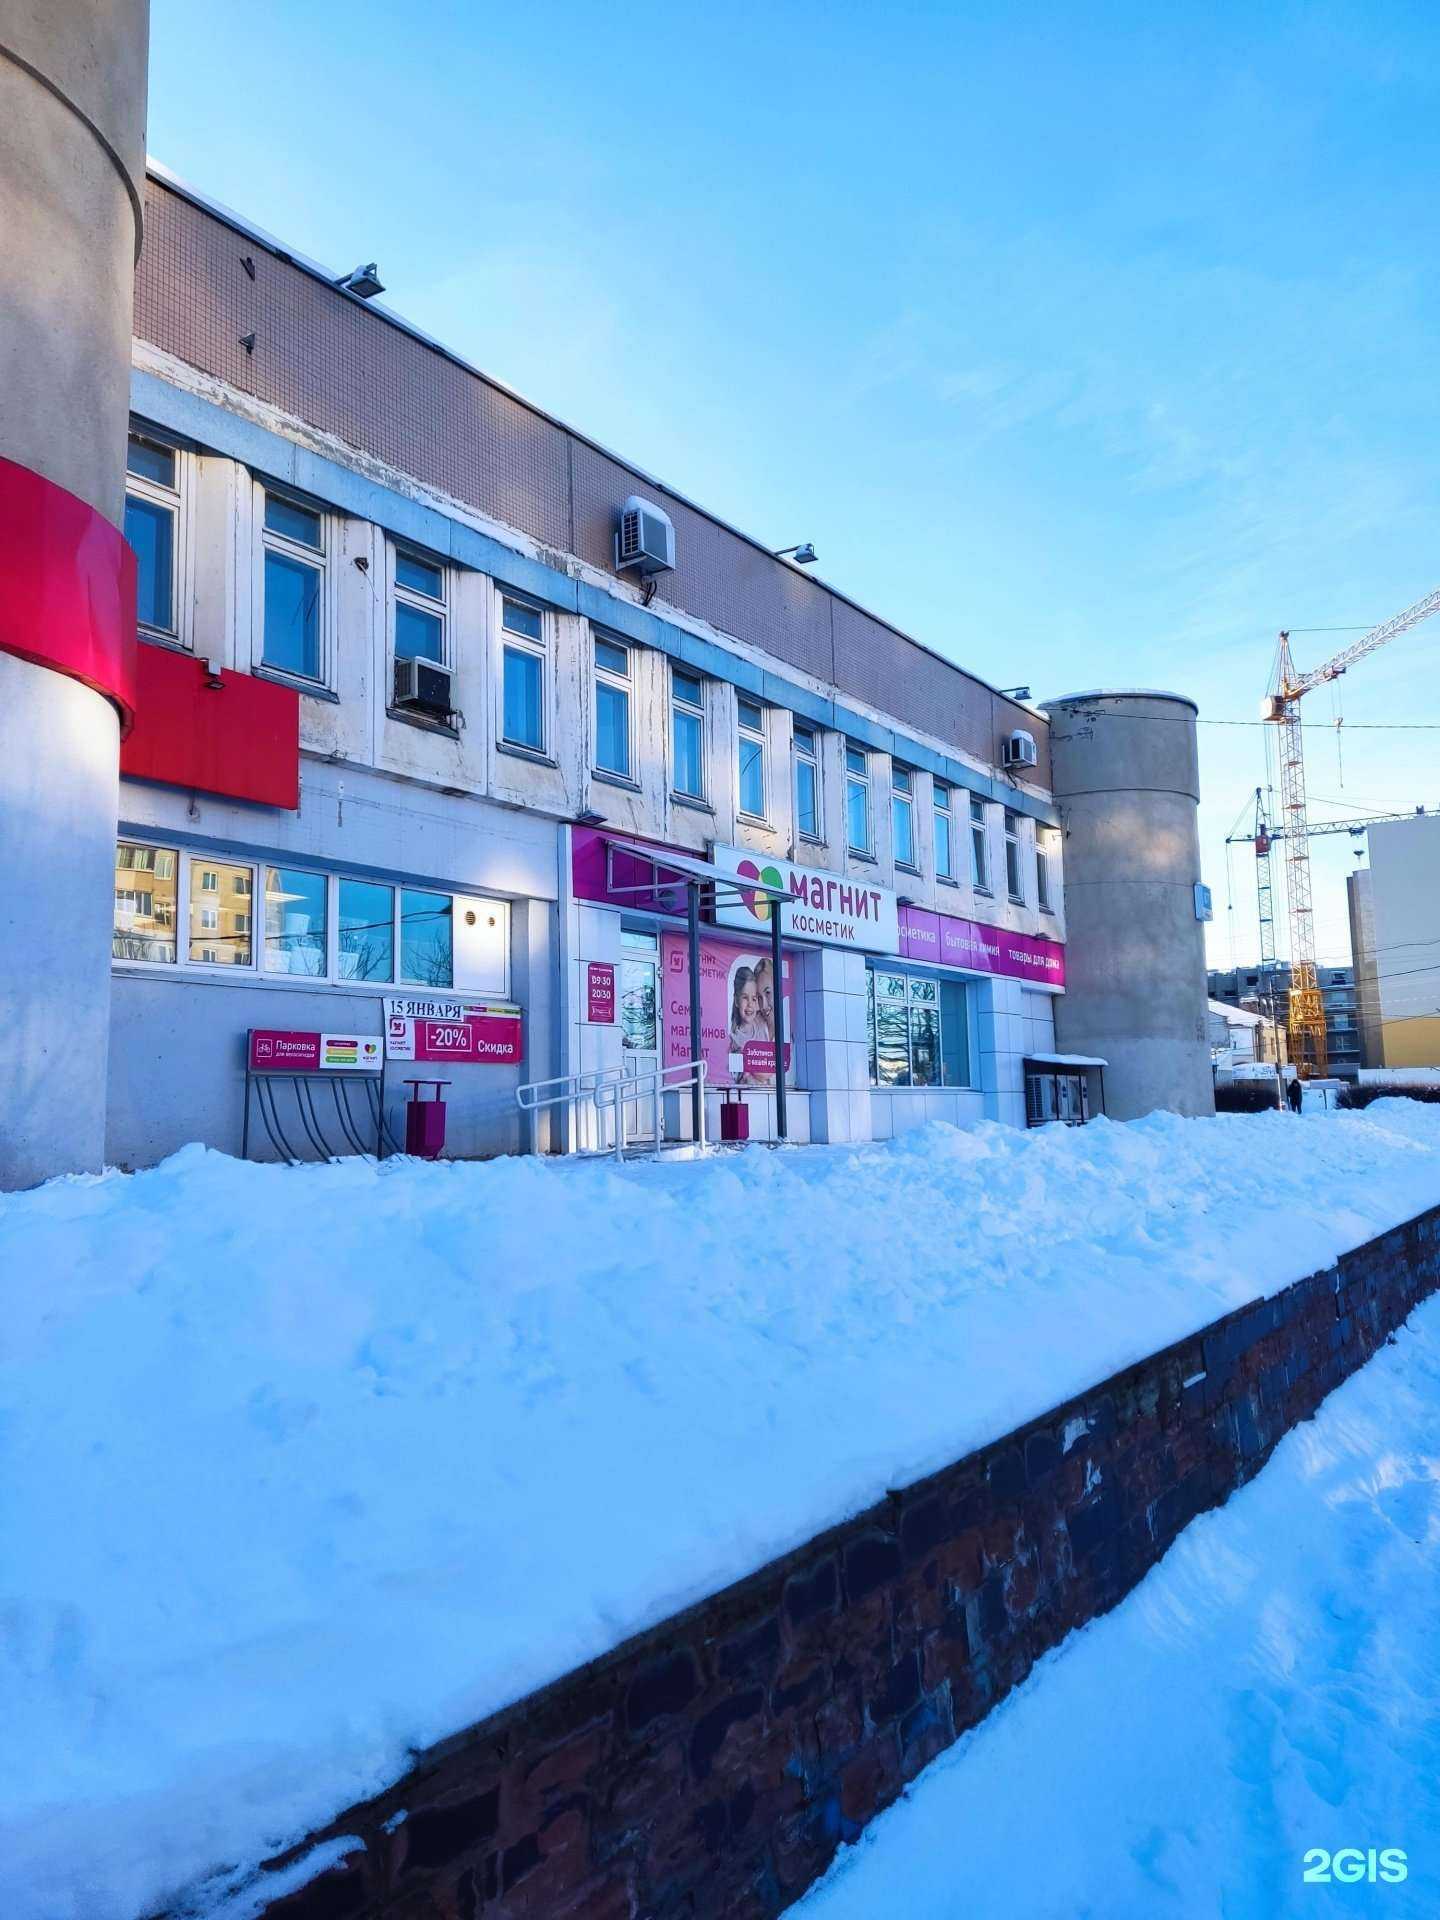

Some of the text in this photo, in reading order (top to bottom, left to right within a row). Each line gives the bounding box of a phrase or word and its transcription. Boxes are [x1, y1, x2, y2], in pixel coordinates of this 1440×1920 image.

[898, 926, 936, 944] осметика
[1008, 949, 1032, 965] товары
[1033, 954, 1045, 967] для
[1045, 957, 1060, 970] дома
[390, 1000, 462, 1019] 15 ЯНВАРЯ
[430, 1027, 467, 1047] -20%
[671, 1025, 726, 1040] магинов
[275, 1040, 316, 1052] Парковка
[477, 1039, 514, 1056] Скидка
[671, 1042, 710, 1058] Магит
